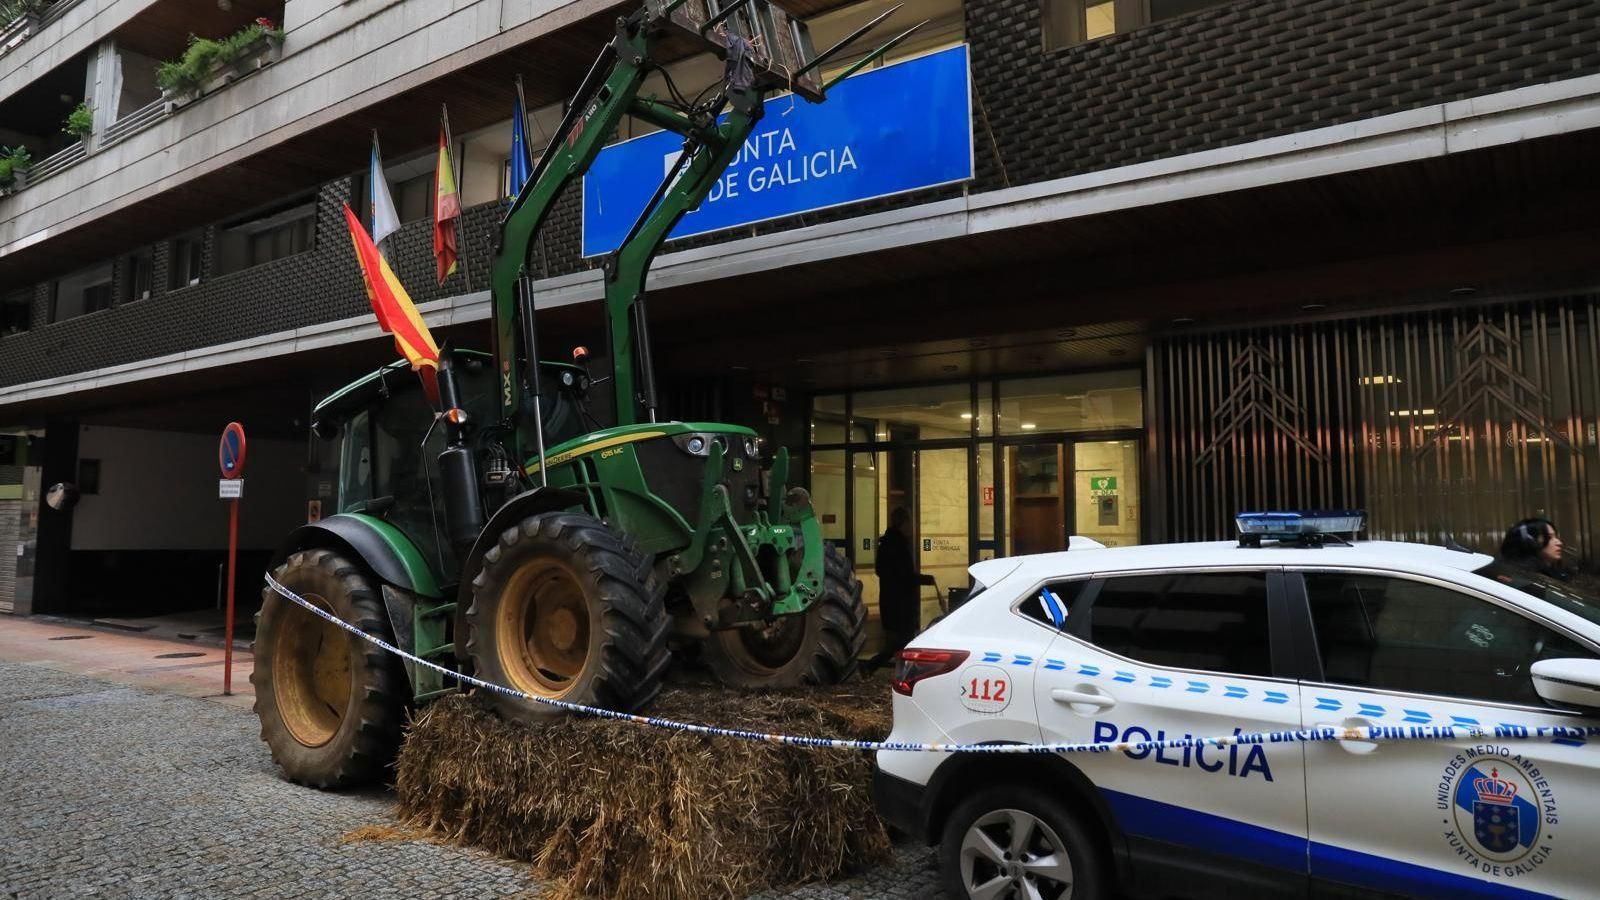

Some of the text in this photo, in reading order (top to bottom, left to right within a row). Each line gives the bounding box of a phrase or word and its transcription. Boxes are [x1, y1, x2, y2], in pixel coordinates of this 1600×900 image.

[708, 146, 857, 202] DE GALICIA
[968, 677, 1006, 702] 112
[1092, 720, 1274, 782] POLICÍA
[1437, 744, 1559, 825] UNIDADES MEDIO AMBIENTAIS
[1444, 830, 1553, 878] XUNTA DE GALICIA
